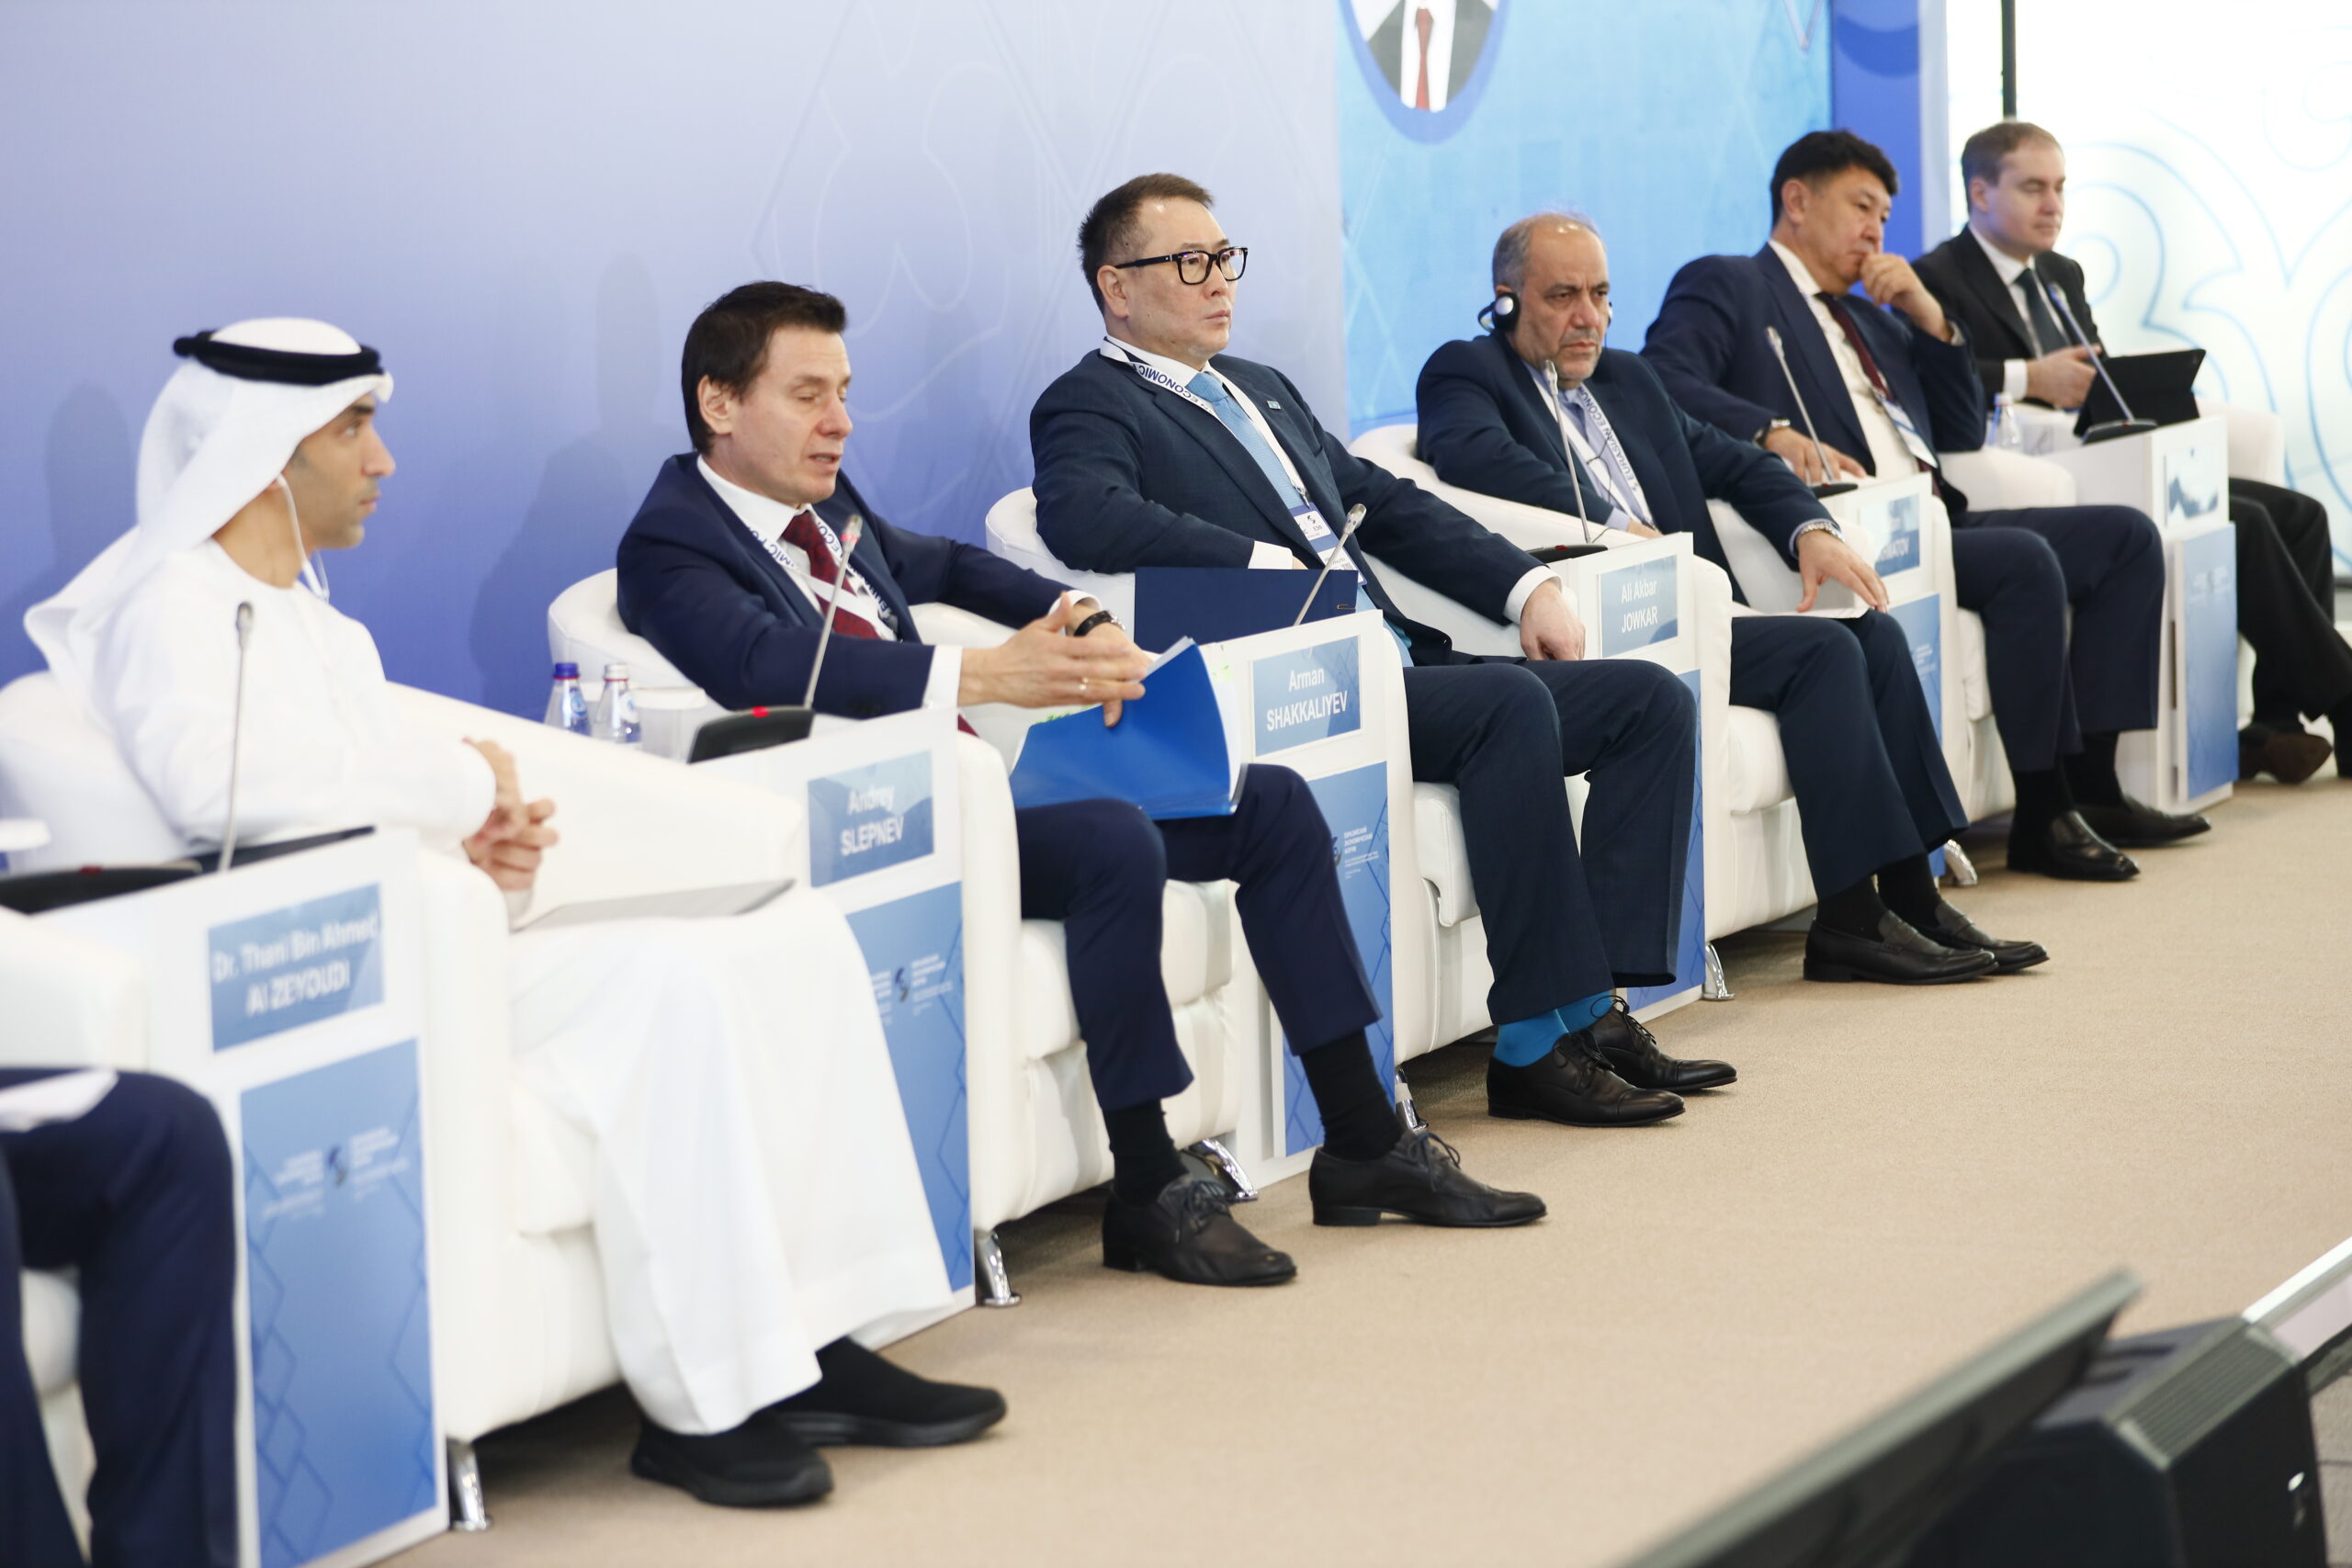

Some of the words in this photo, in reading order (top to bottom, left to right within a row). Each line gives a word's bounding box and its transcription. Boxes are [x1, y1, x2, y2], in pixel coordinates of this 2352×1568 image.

[1138, 365, 1199, 402] ECONOMIC
[1621, 582, 1633, 604] Ali
[1634, 578, 1657, 599] Akbar
[1622, 606, 1658, 634] JOWKAR
[1288, 668, 1325, 693] Arman
[1267, 690, 1348, 731] SHAKKALIYEV
[841, 816, 904, 856] SLEPNEV
